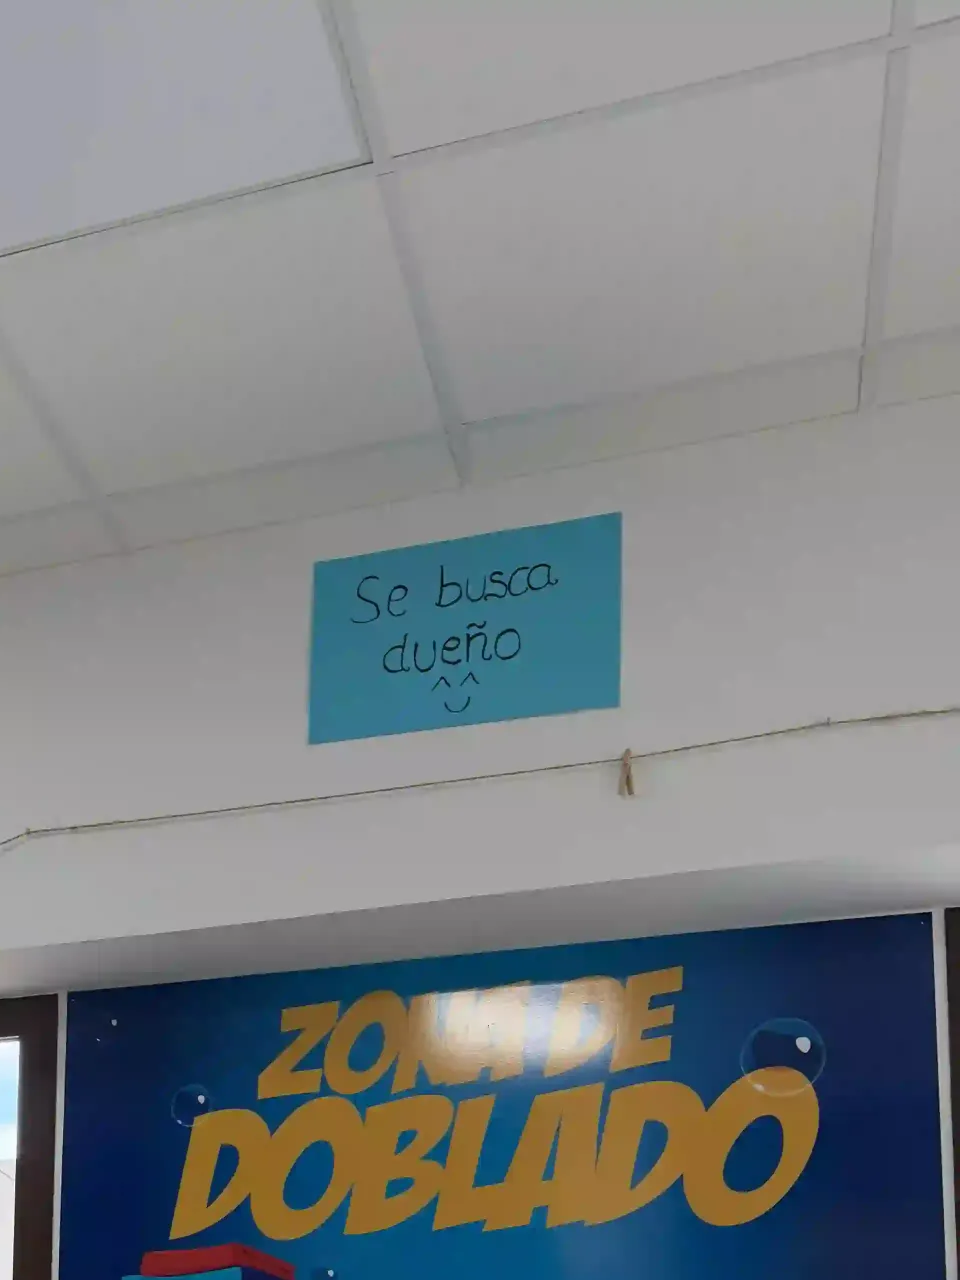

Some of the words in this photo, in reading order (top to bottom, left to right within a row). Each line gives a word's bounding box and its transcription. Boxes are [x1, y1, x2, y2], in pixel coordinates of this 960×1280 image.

[349, 575, 409, 624] Se
[435, 563, 559, 608] busca
[382, 620, 522, 673] dueño
[258, 981, 532, 1100] ZONA
[543, 966, 684, 1078] DE
[169, 1065, 820, 1241] DOBLADO
